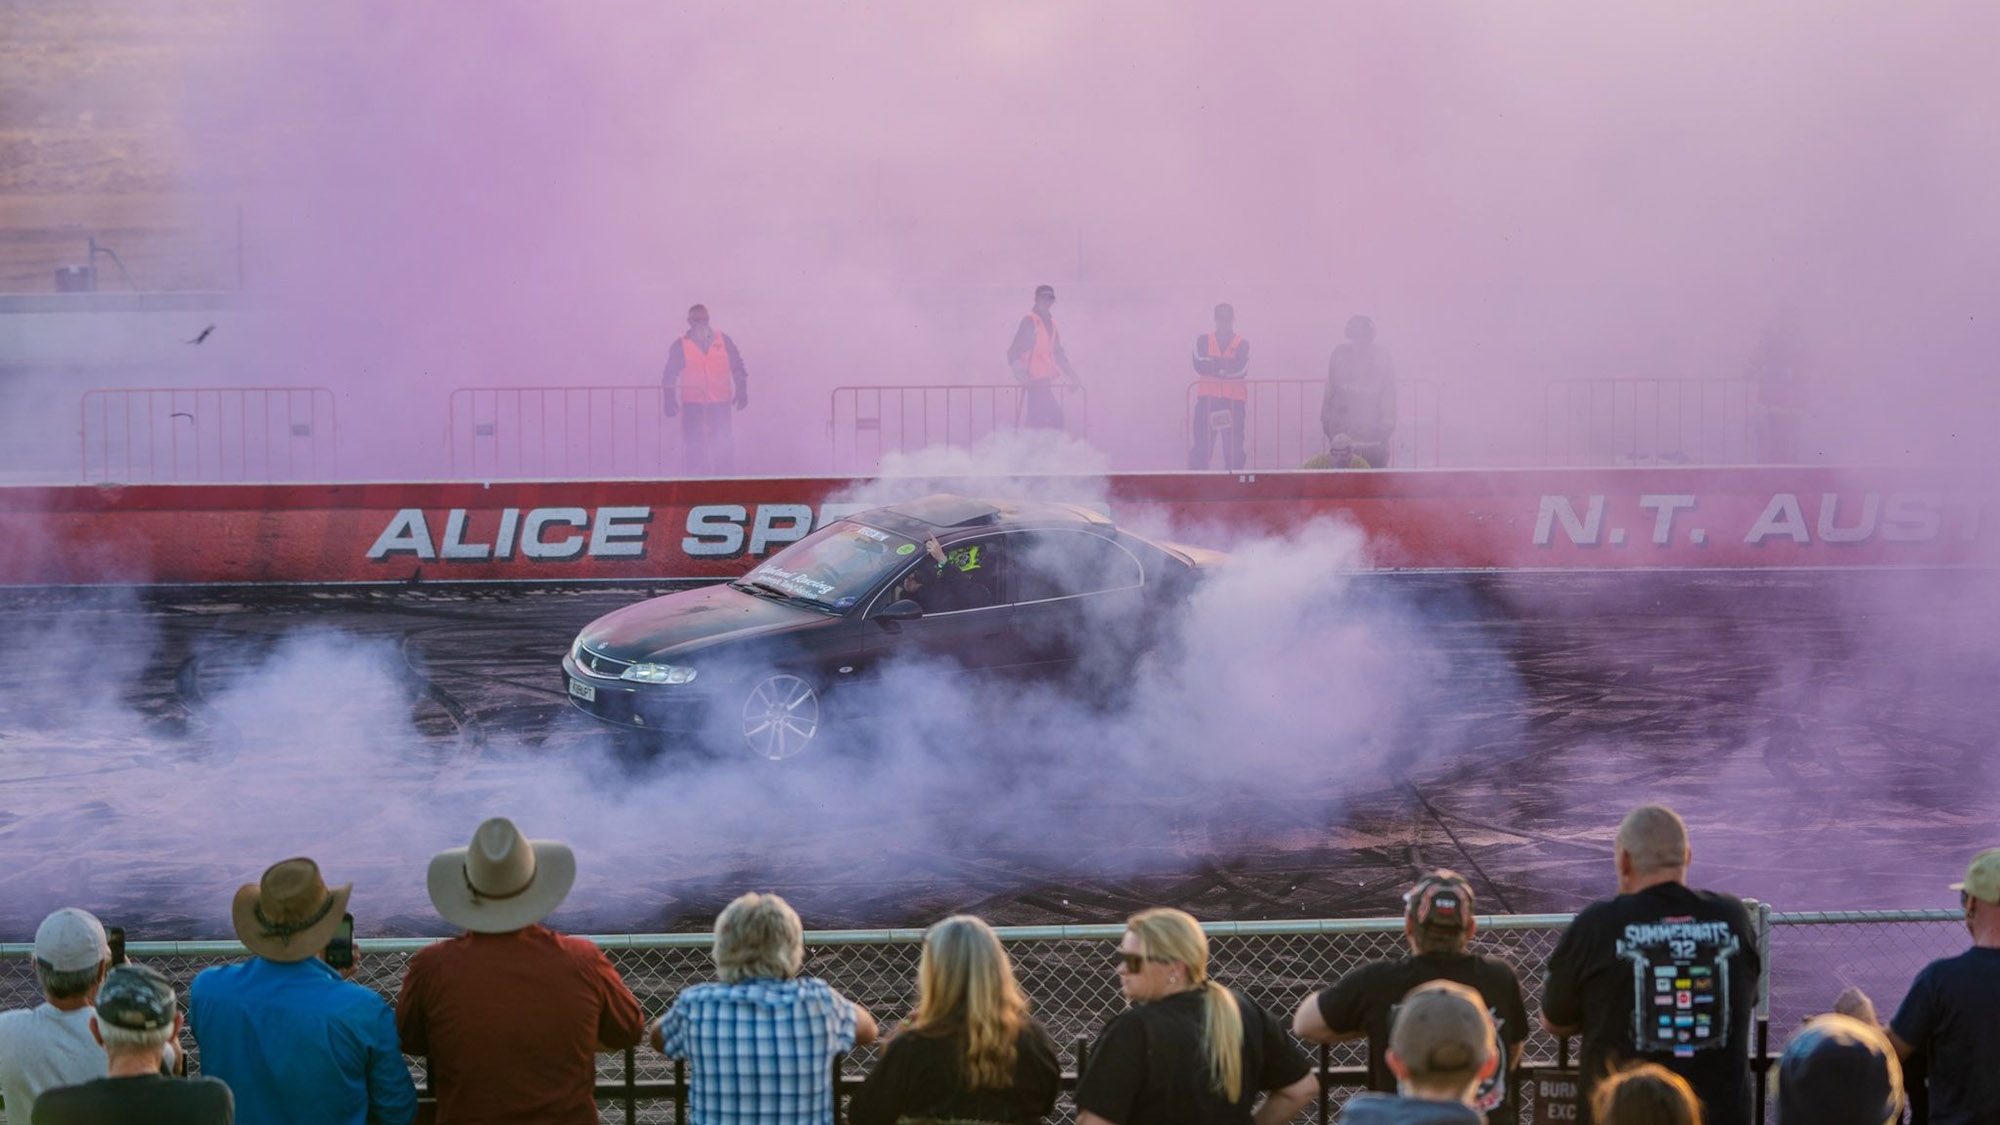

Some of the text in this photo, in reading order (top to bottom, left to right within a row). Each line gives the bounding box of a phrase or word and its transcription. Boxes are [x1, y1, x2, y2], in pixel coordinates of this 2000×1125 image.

[366, 506, 651, 560] ALICE
[1532, 494, 1706, 546] N.T.
[1624, 921, 1730, 949] SUMMERNATS
[1669, 940, 1697, 959] 32
[1547, 1103, 1576, 1120] EXC
